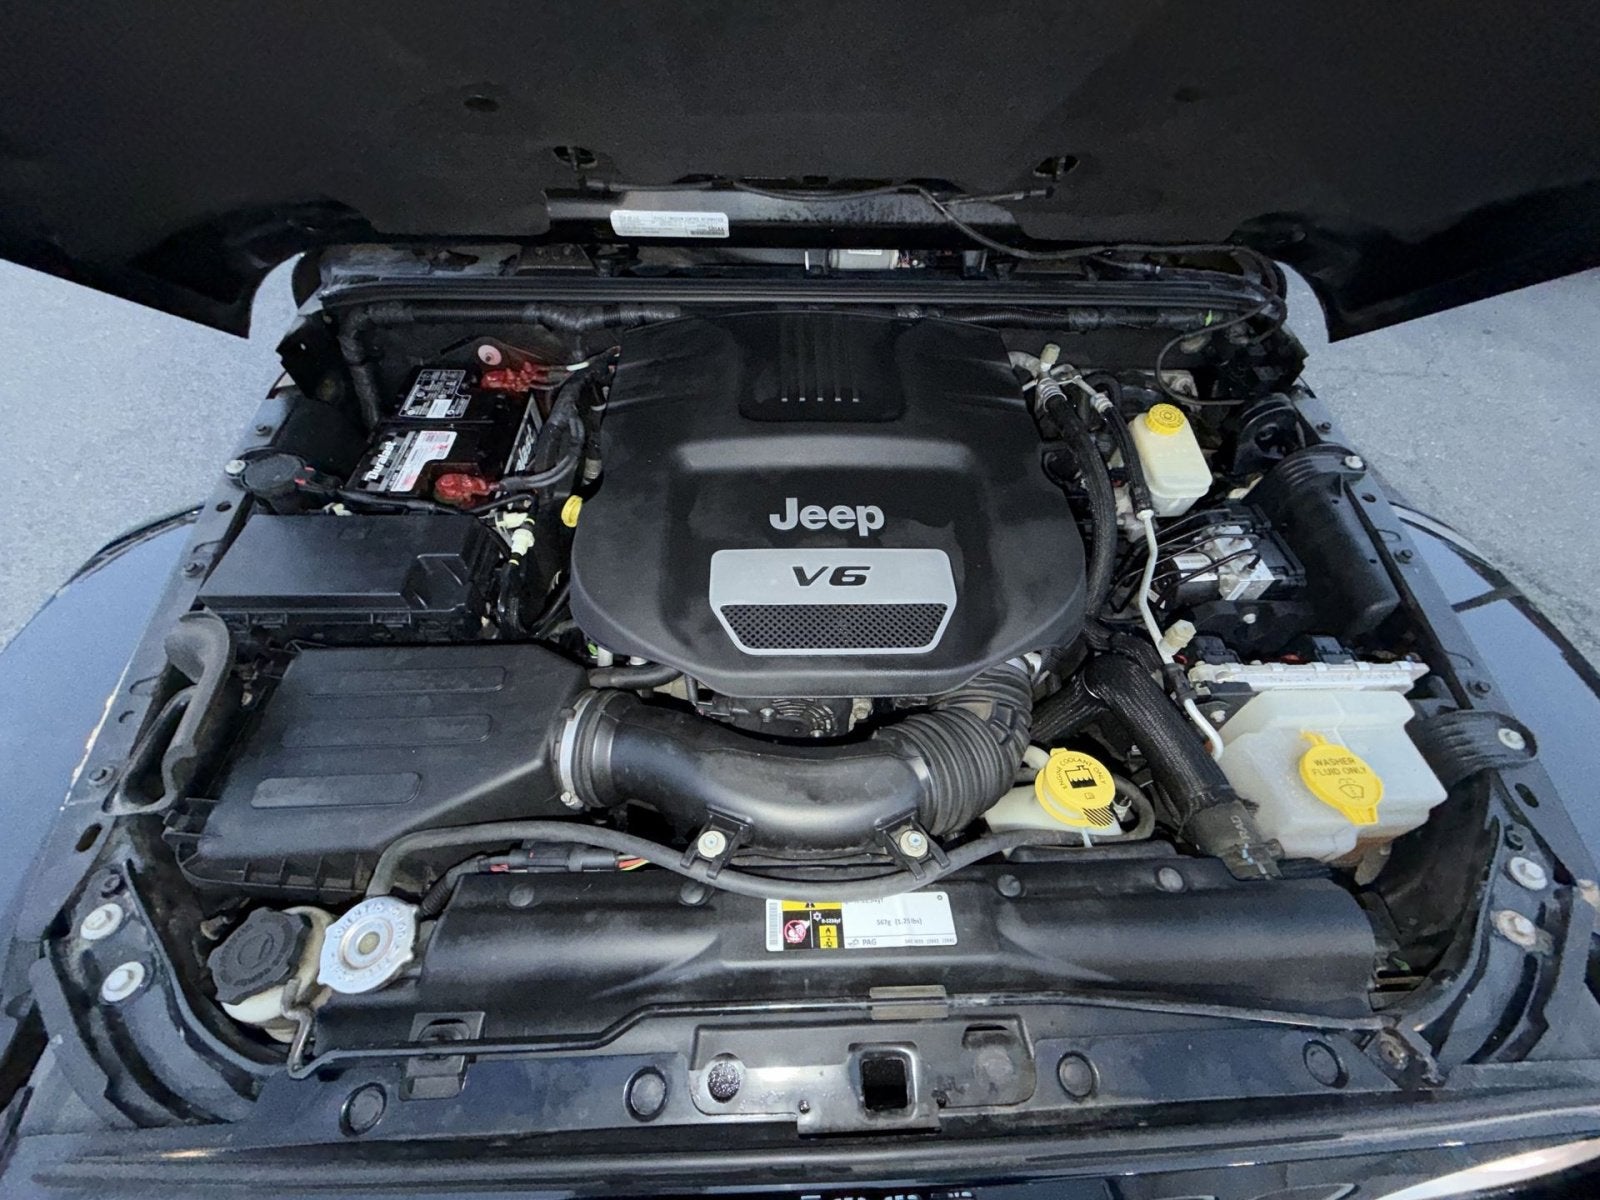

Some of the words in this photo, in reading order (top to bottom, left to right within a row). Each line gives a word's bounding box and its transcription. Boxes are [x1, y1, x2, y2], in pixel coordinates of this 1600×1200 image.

[365, 440, 397, 482] Duralast
[769, 497, 885, 537] Jeep
[792, 566, 871, 587] V6
[1313, 757, 1355, 766] WASHER
[1059, 757, 1093, 767] COOLANT
[1093, 766, 1107, 785] ONLY
[1312, 768, 1340, 776] FLUID
[1343, 767, 1367, 775] ONLY
[876, 918, 892, 927] 567g
[862, 937, 878, 946] PAG
